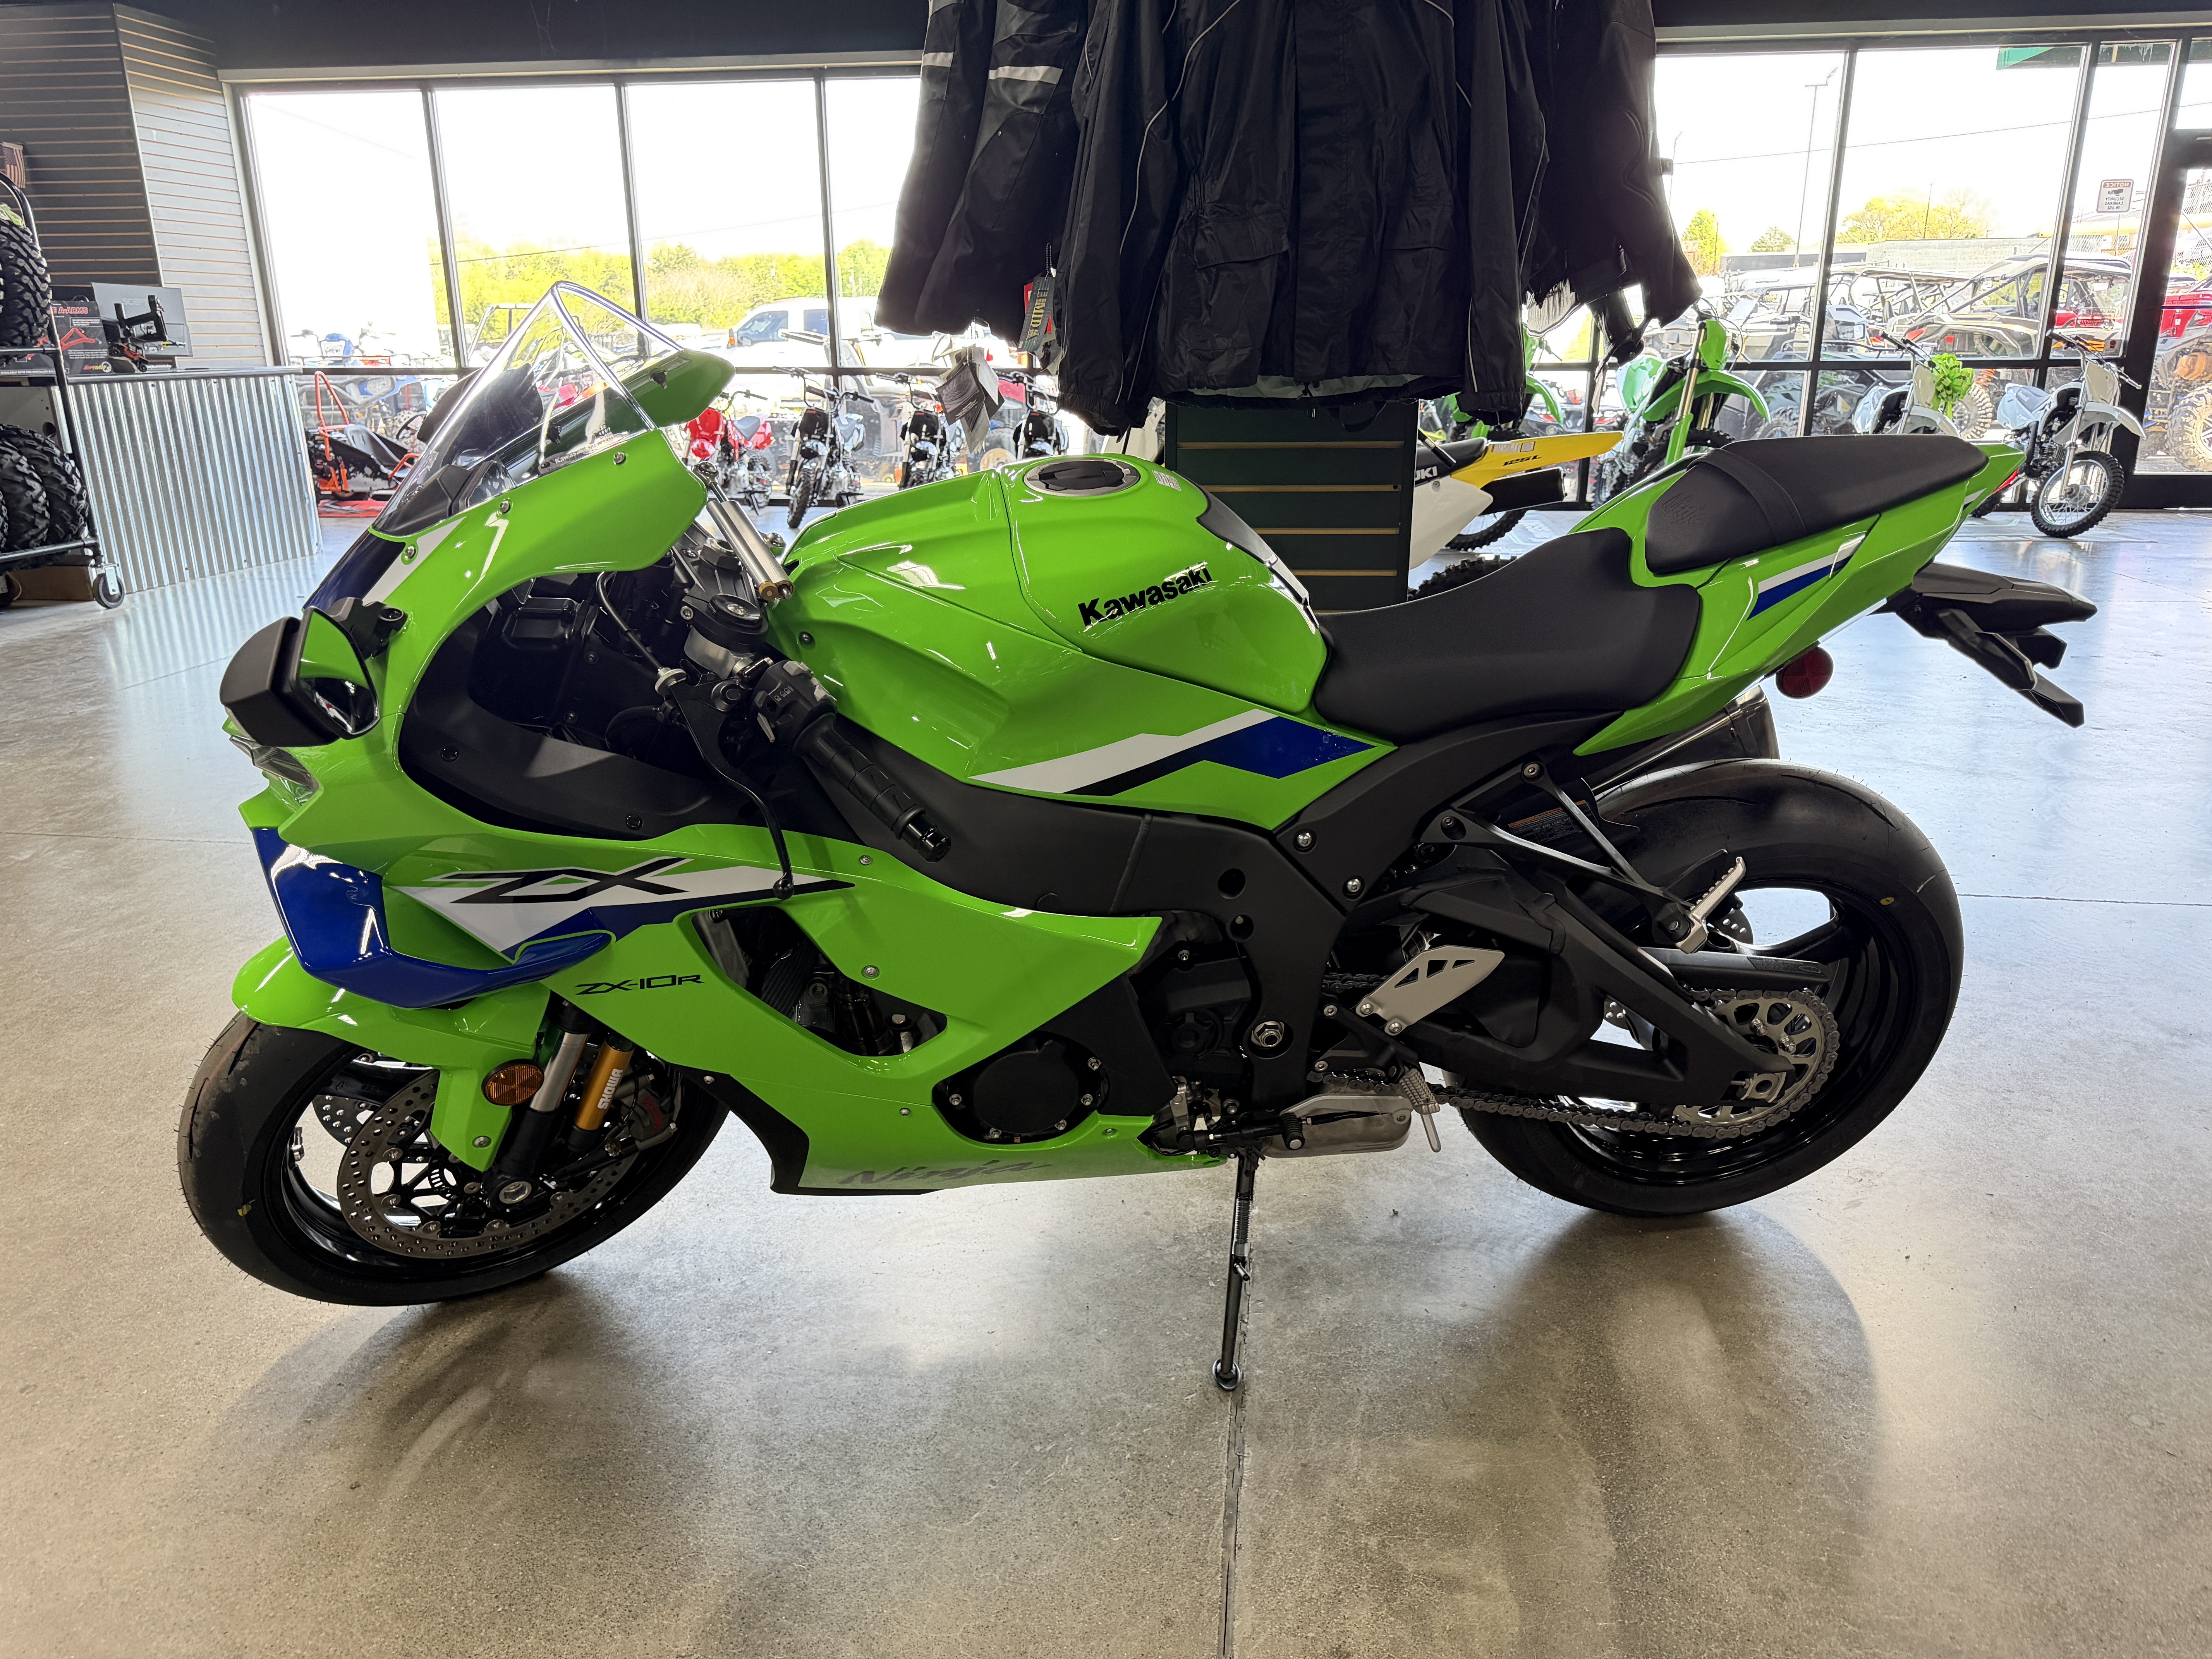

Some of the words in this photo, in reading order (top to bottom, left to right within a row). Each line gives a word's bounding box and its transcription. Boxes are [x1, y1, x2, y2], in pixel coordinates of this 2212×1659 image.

[1078, 562, 1212, 627] Kawasaki
[441, 857, 691, 904] ZX
[575, 974, 704, 995] ZX-10R
[597, 1068, 623, 1109] SHOWA
[838, 1159, 1052, 1185] Ninja
